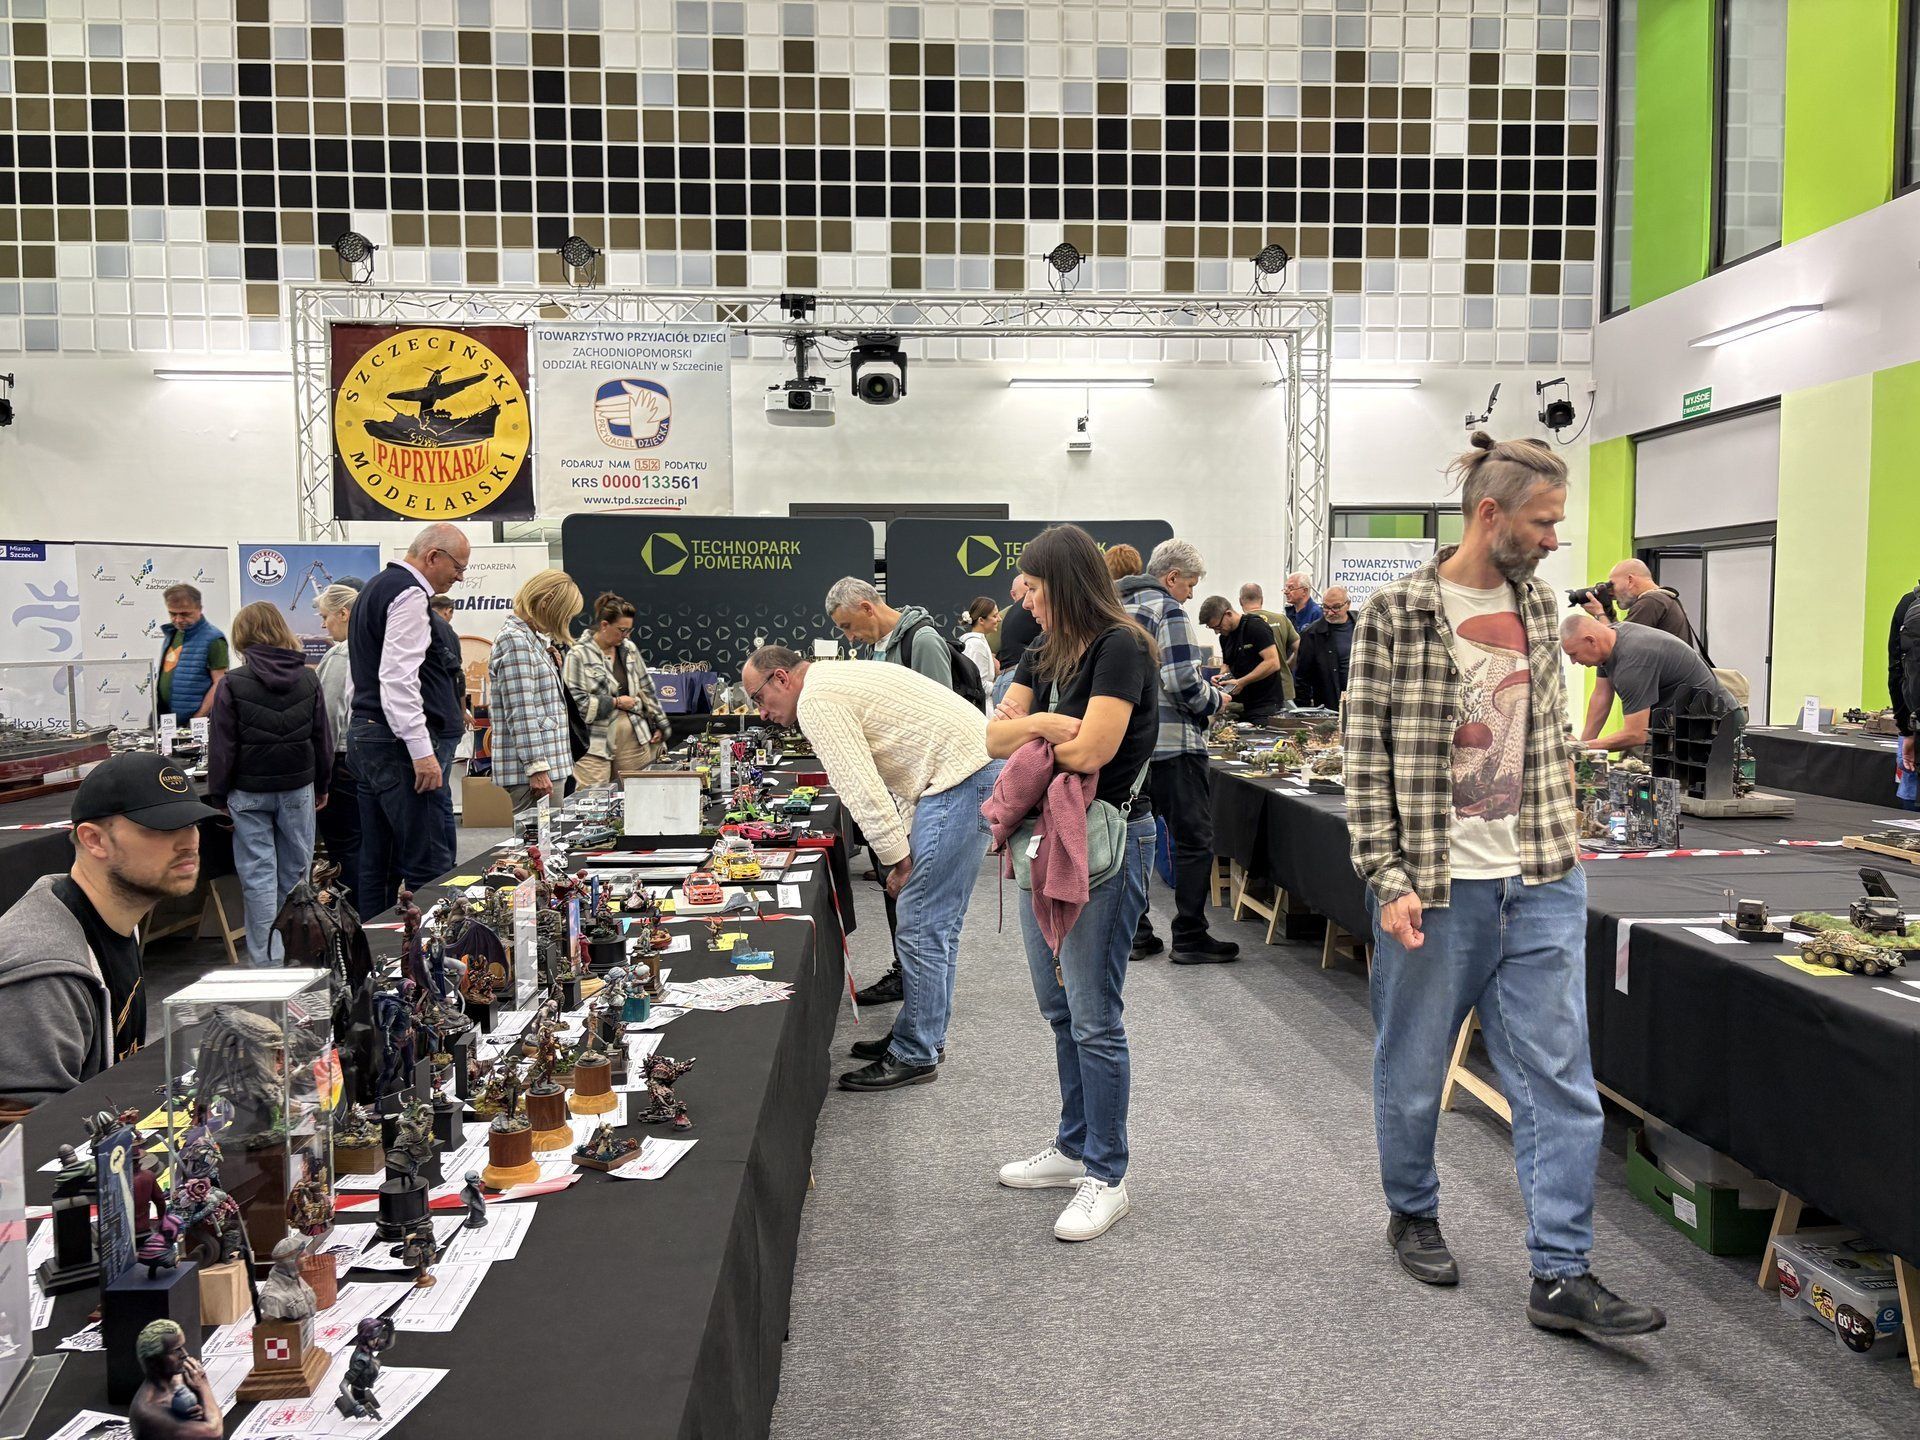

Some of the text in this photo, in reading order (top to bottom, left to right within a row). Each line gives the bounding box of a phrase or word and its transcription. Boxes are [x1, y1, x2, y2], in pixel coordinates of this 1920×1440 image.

[538, 330, 726, 343] TOWARZYSTWO PRZYJACIÓŁ DZIECI
[572, 347, 692, 358] ZACHODNIOPOMORSKI
[347, 337, 518, 405] SZCZECIŃSKI
[542, 360, 587, 370] ODDZIAŁ
[590, 360, 658, 371] REGIONALNY
[672, 361, 723, 372] Szczecinie
[597, 418, 669, 448] PRZYJACIEL DZIECKA
[377, 442, 486, 483] PAPRYKARZ
[560, 459, 604, 469] PODARUJ
[608, 460, 631, 469] NAM
[664, 461, 708, 471] PODATKU
[350, 450, 516, 511] MODELARSKI
[571, 474, 699, 490] KRS 0000133561
[583, 495, 688, 506] www.tpd.szczecin.pl
[691, 540, 801, 555] TECHNOPARK
[469, 563, 516, 571] WYDARZENIA
[694, 555, 793, 570] POMERANIA
[1335, 570, 1394, 582] PRZYJACIÓŁ
